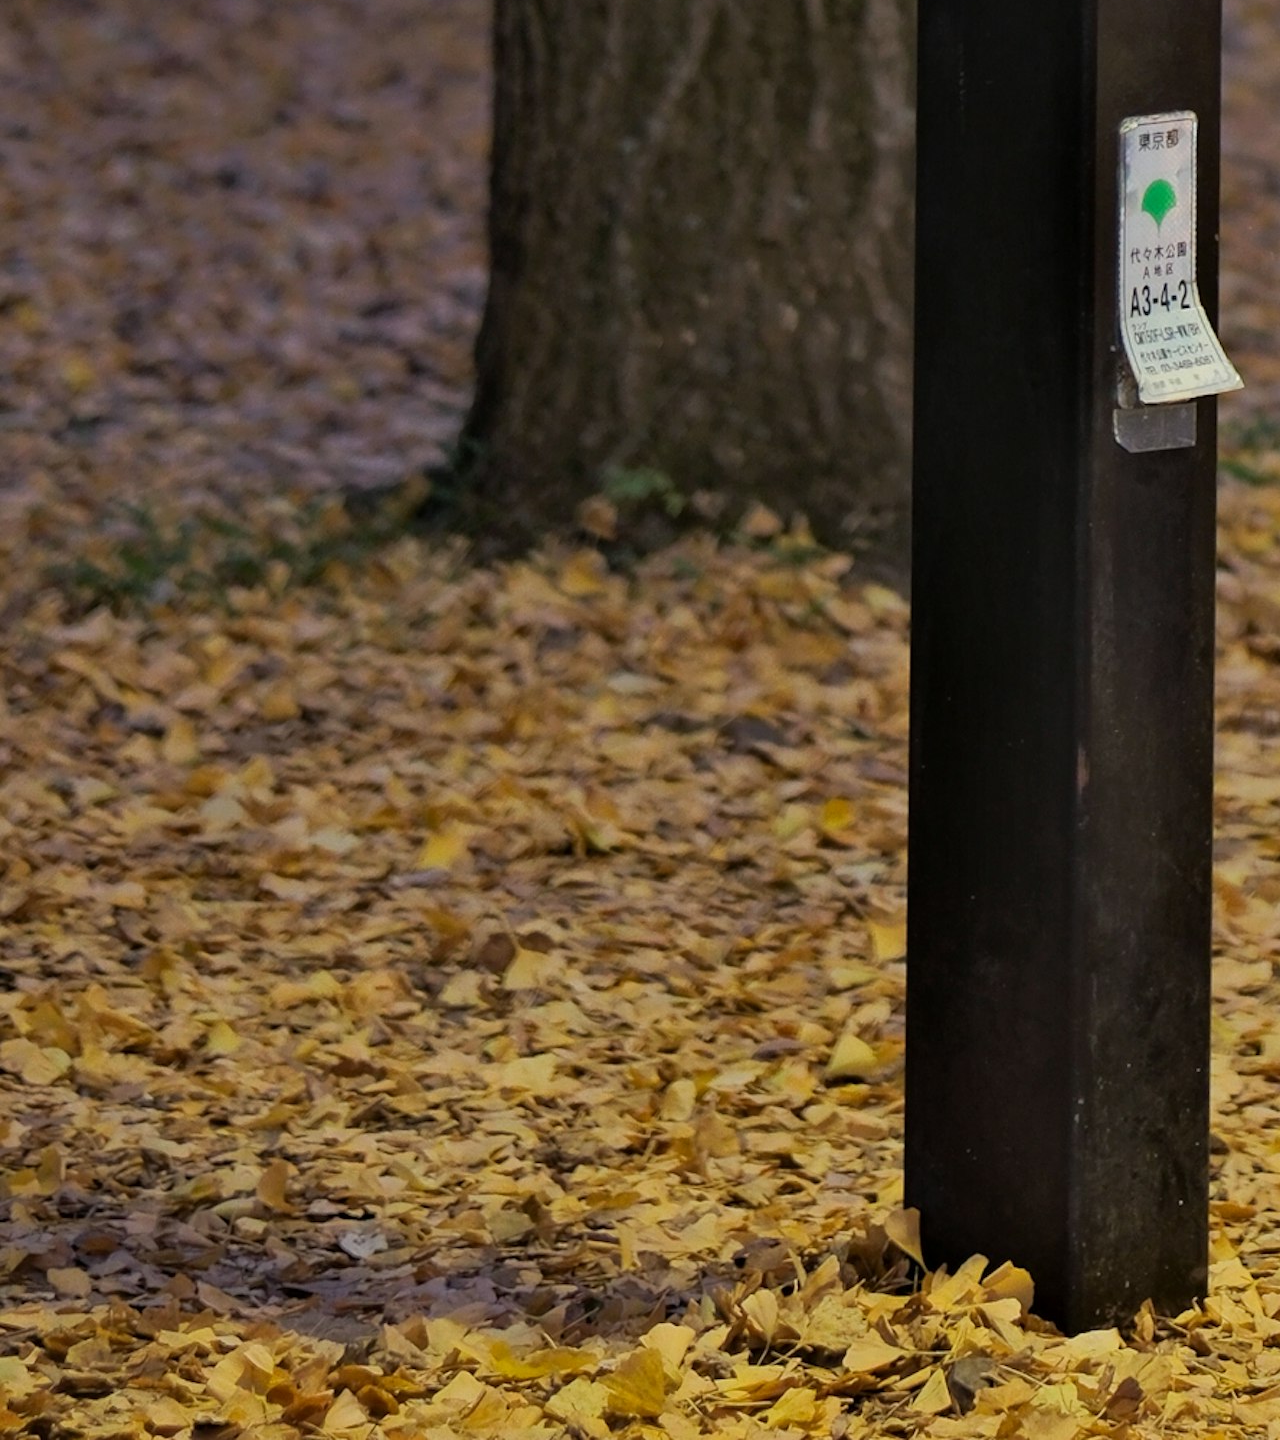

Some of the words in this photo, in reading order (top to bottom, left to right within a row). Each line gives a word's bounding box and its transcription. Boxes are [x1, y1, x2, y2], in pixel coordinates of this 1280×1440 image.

[1138, 129, 1179, 152] 東京都
[1131, 241, 1187, 264] 代々木公園
[1130, 279, 1191, 318] A3-4-2
